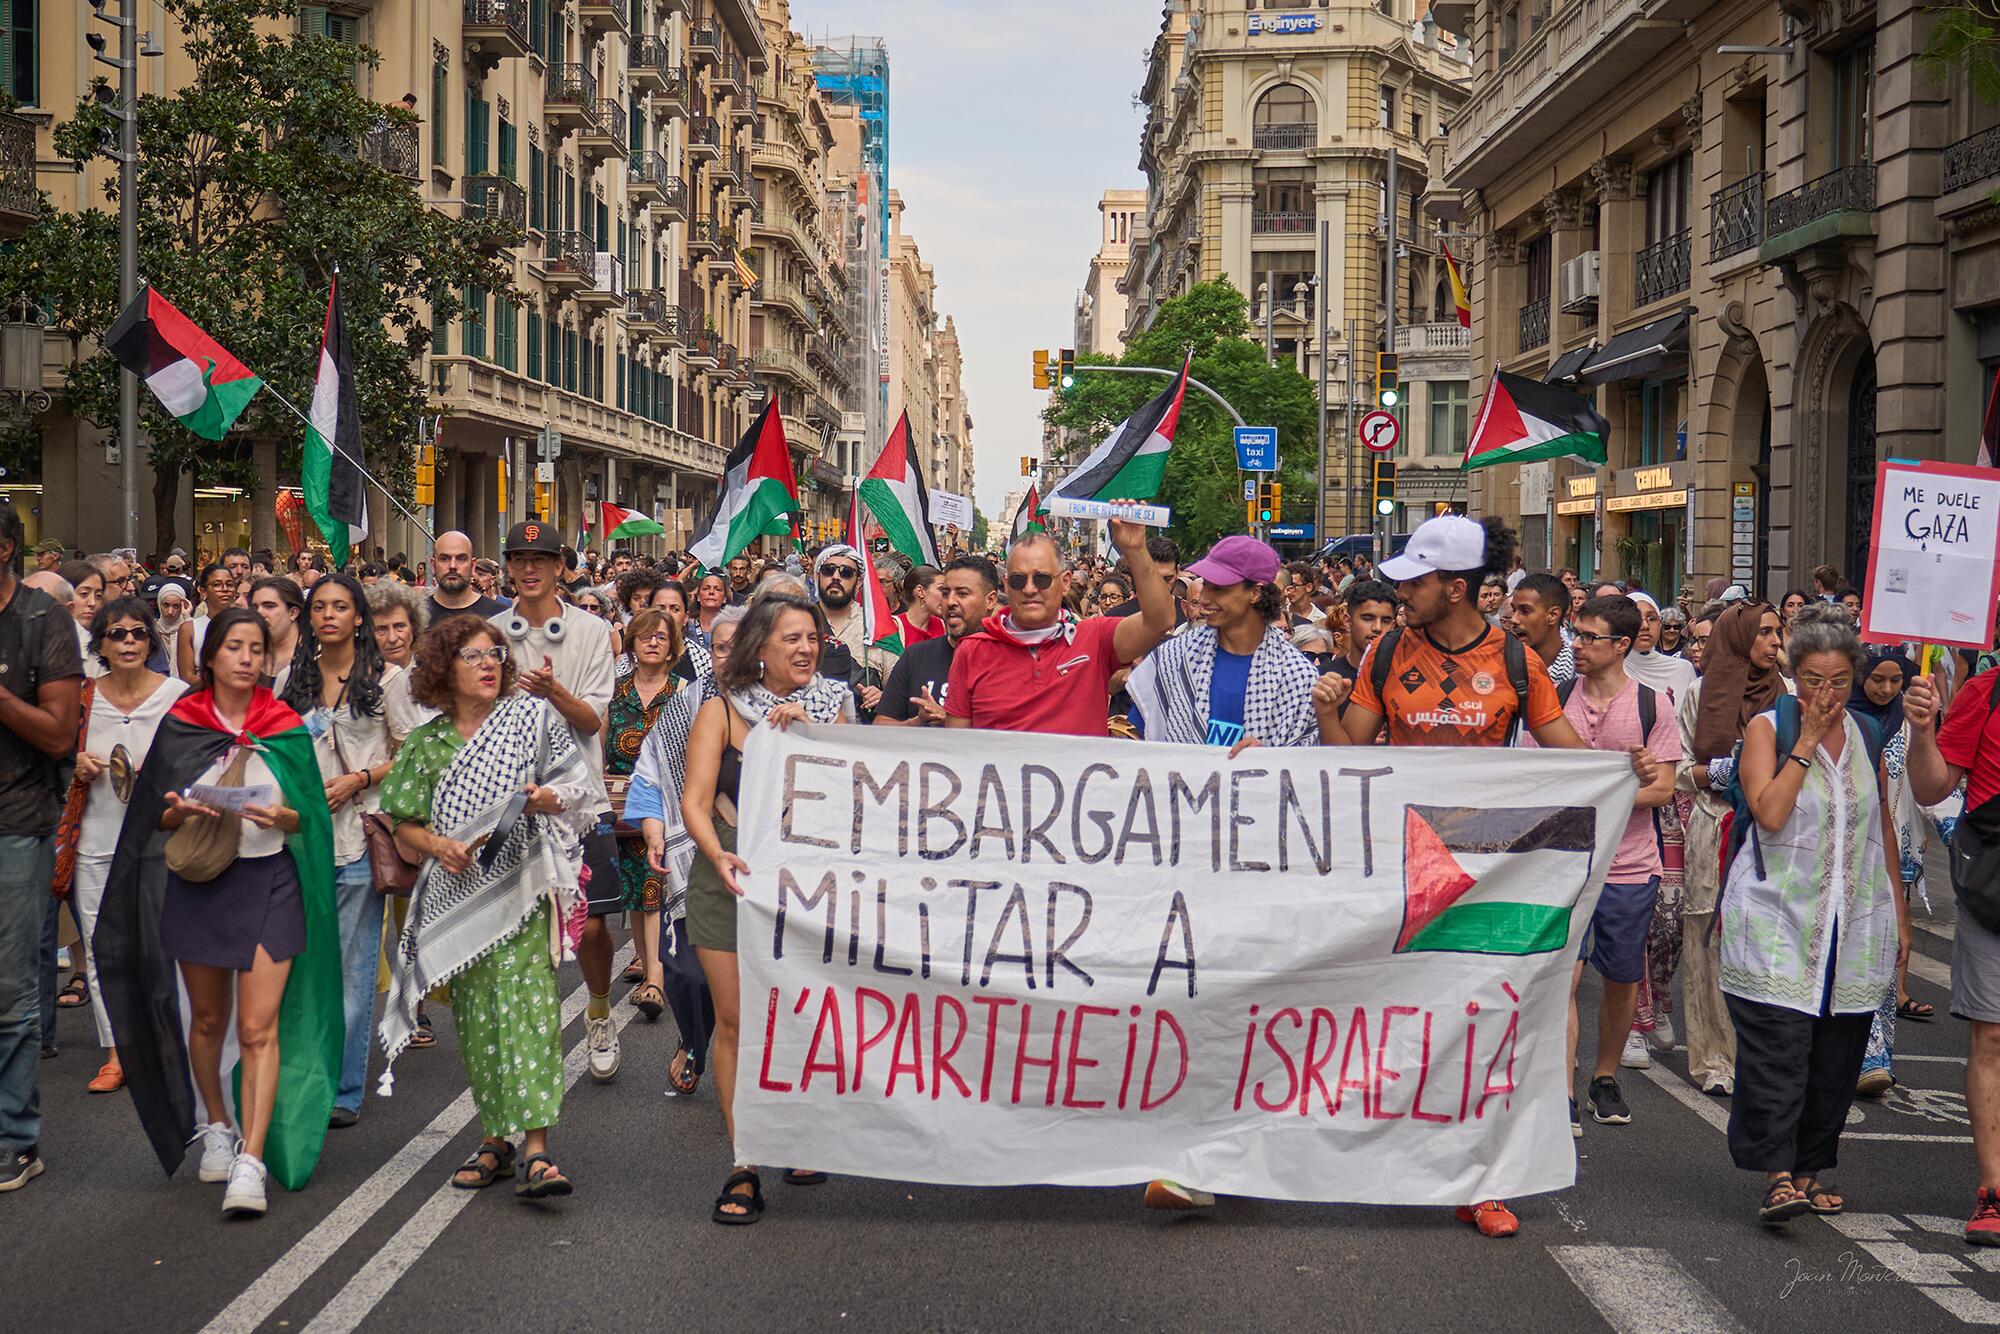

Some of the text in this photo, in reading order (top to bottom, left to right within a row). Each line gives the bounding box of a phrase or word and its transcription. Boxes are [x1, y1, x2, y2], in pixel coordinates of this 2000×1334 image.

[1248, 16, 1324, 32] Enginyers
[1246, 447, 1264, 456] taxi
[1903, 486, 1981, 510] ME DUELE
[1069, 503, 1155, 520] FROM THE RIVER TO THE SEA
[1904, 508, 1969, 544] GAZA
[781, 754, 1393, 877] EMBARGAMENT
[1146, 890, 1199, 999] A
